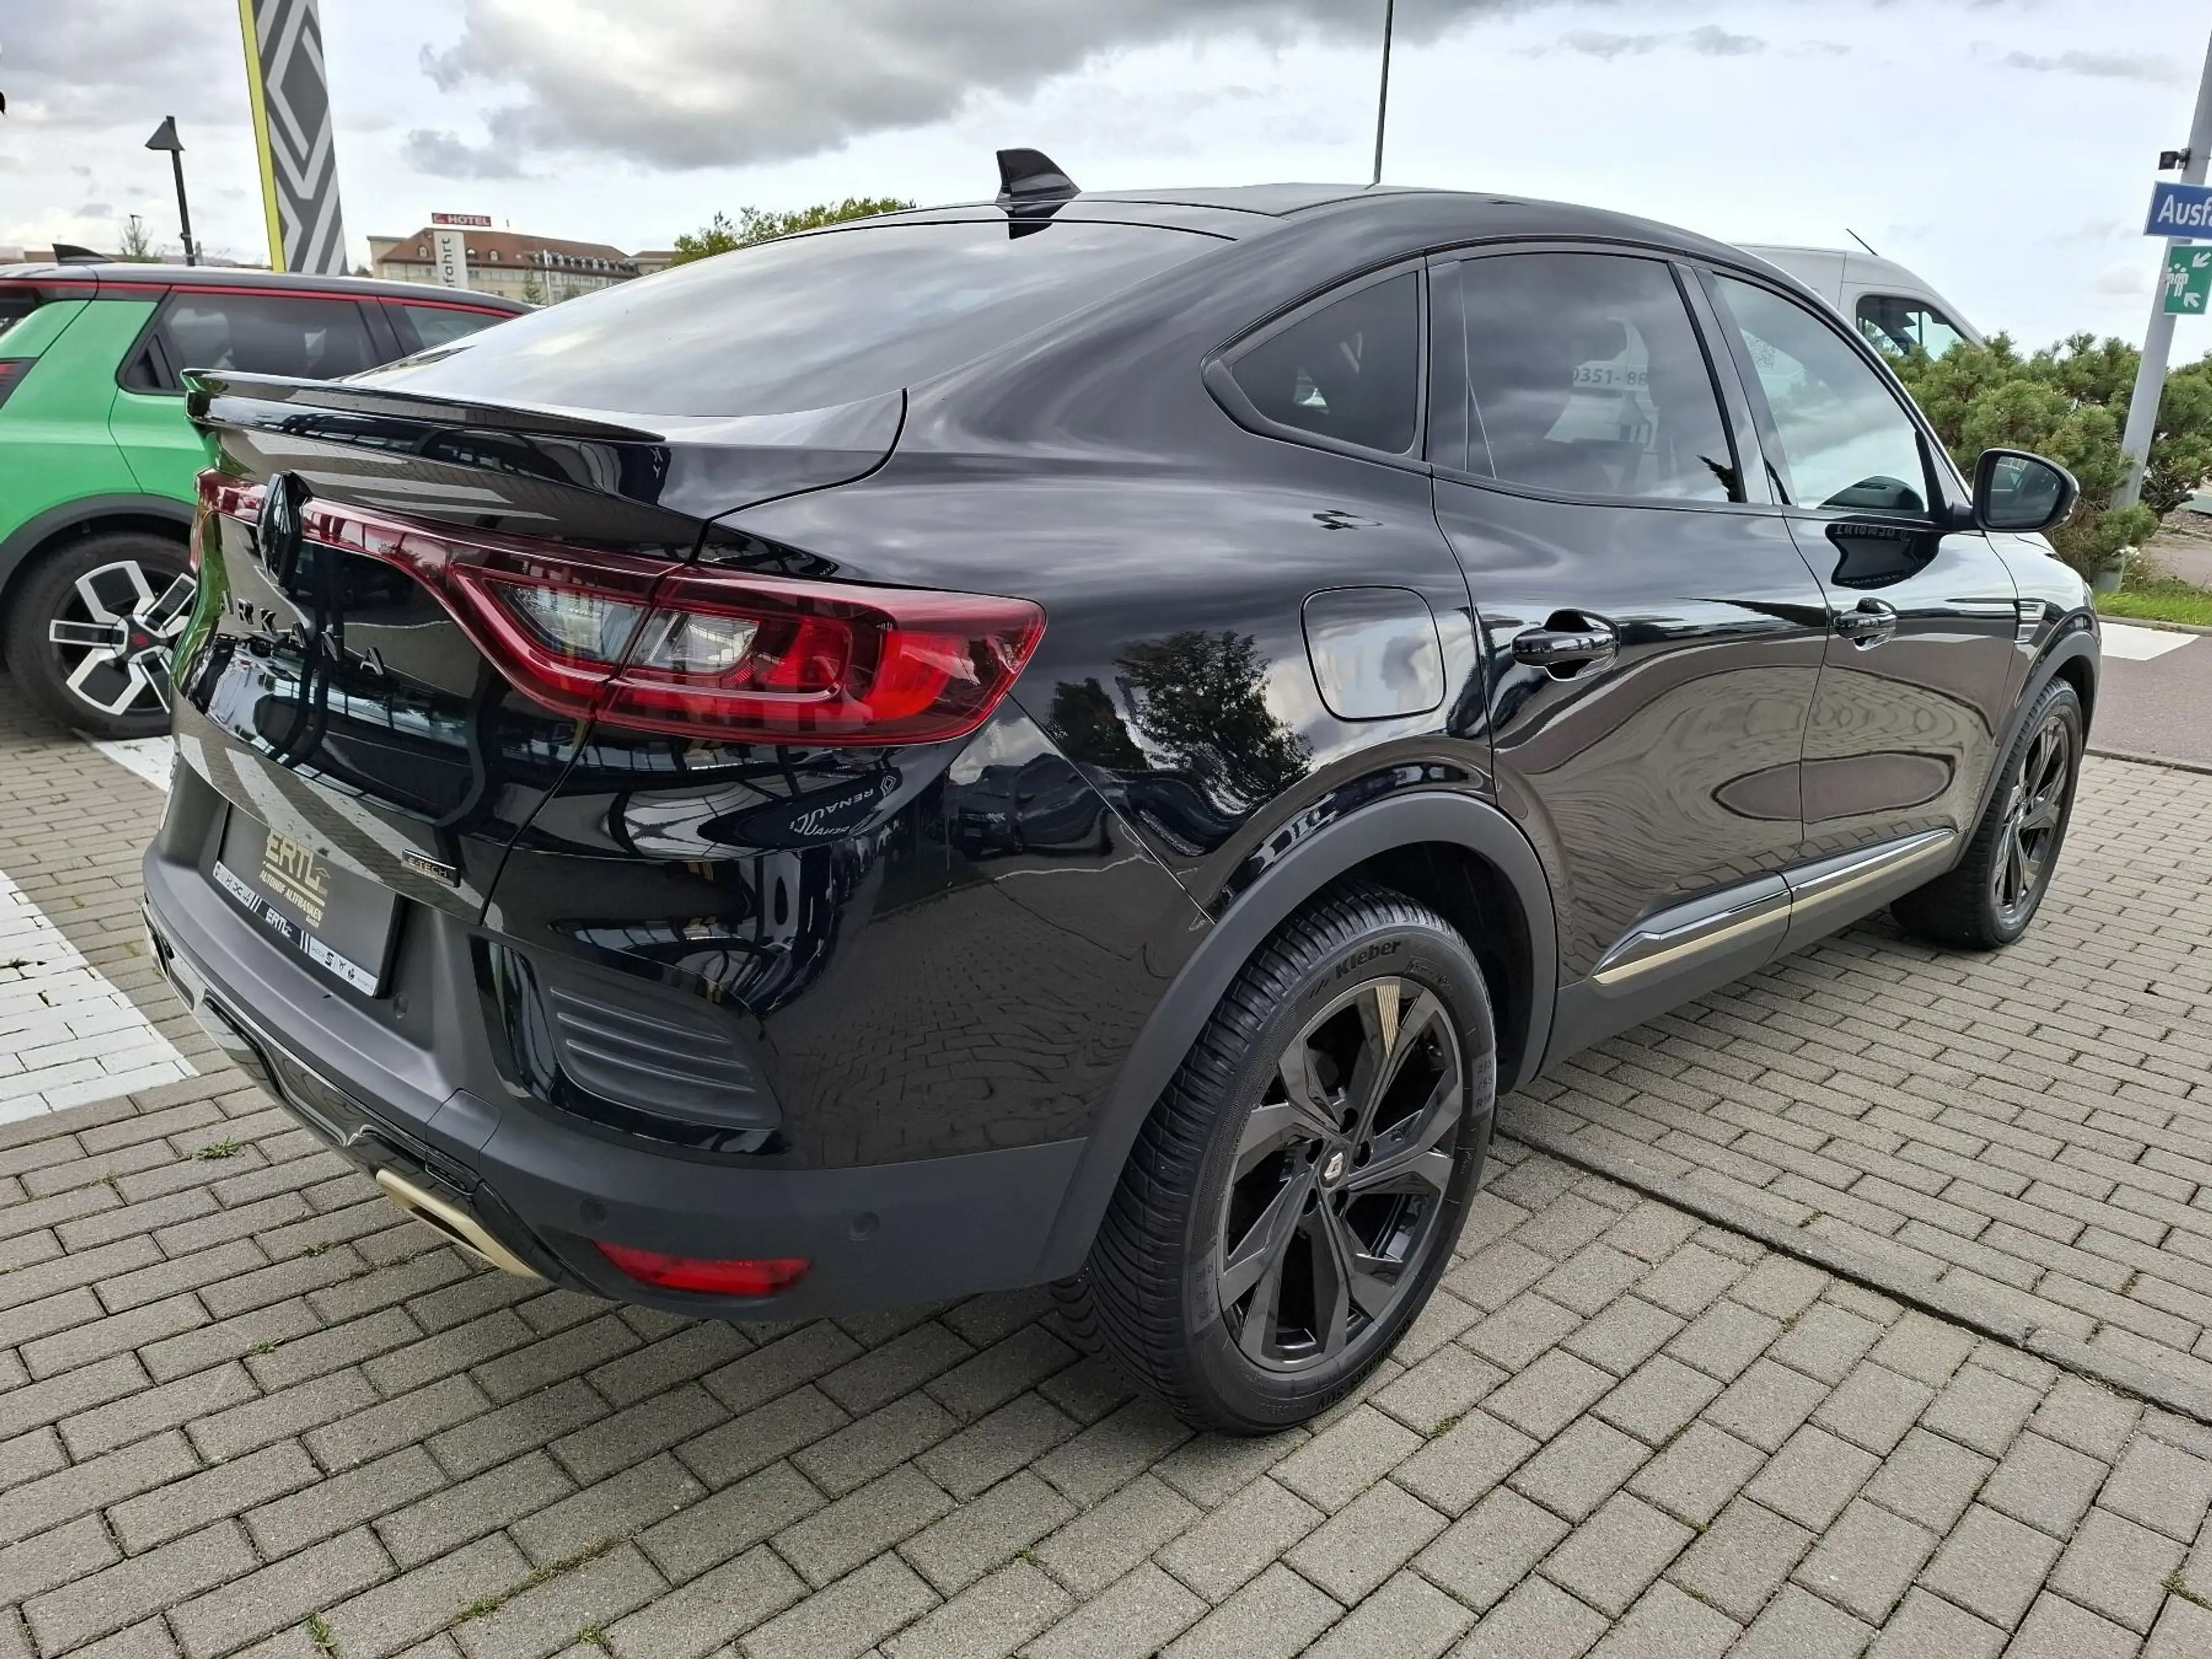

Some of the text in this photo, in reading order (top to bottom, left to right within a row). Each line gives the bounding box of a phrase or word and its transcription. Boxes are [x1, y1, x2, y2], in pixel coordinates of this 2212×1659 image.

[448, 214, 490, 225] HOTEL
[2157, 194, 2212, 227] Ausf
[221, 589, 385, 676] ARKANA
[266, 830, 320, 891] ERTL
[408, 857, 448, 877] E-TECH
[265, 907, 290, 937] ERTL
[1335, 940, 1402, 980] Kleber
